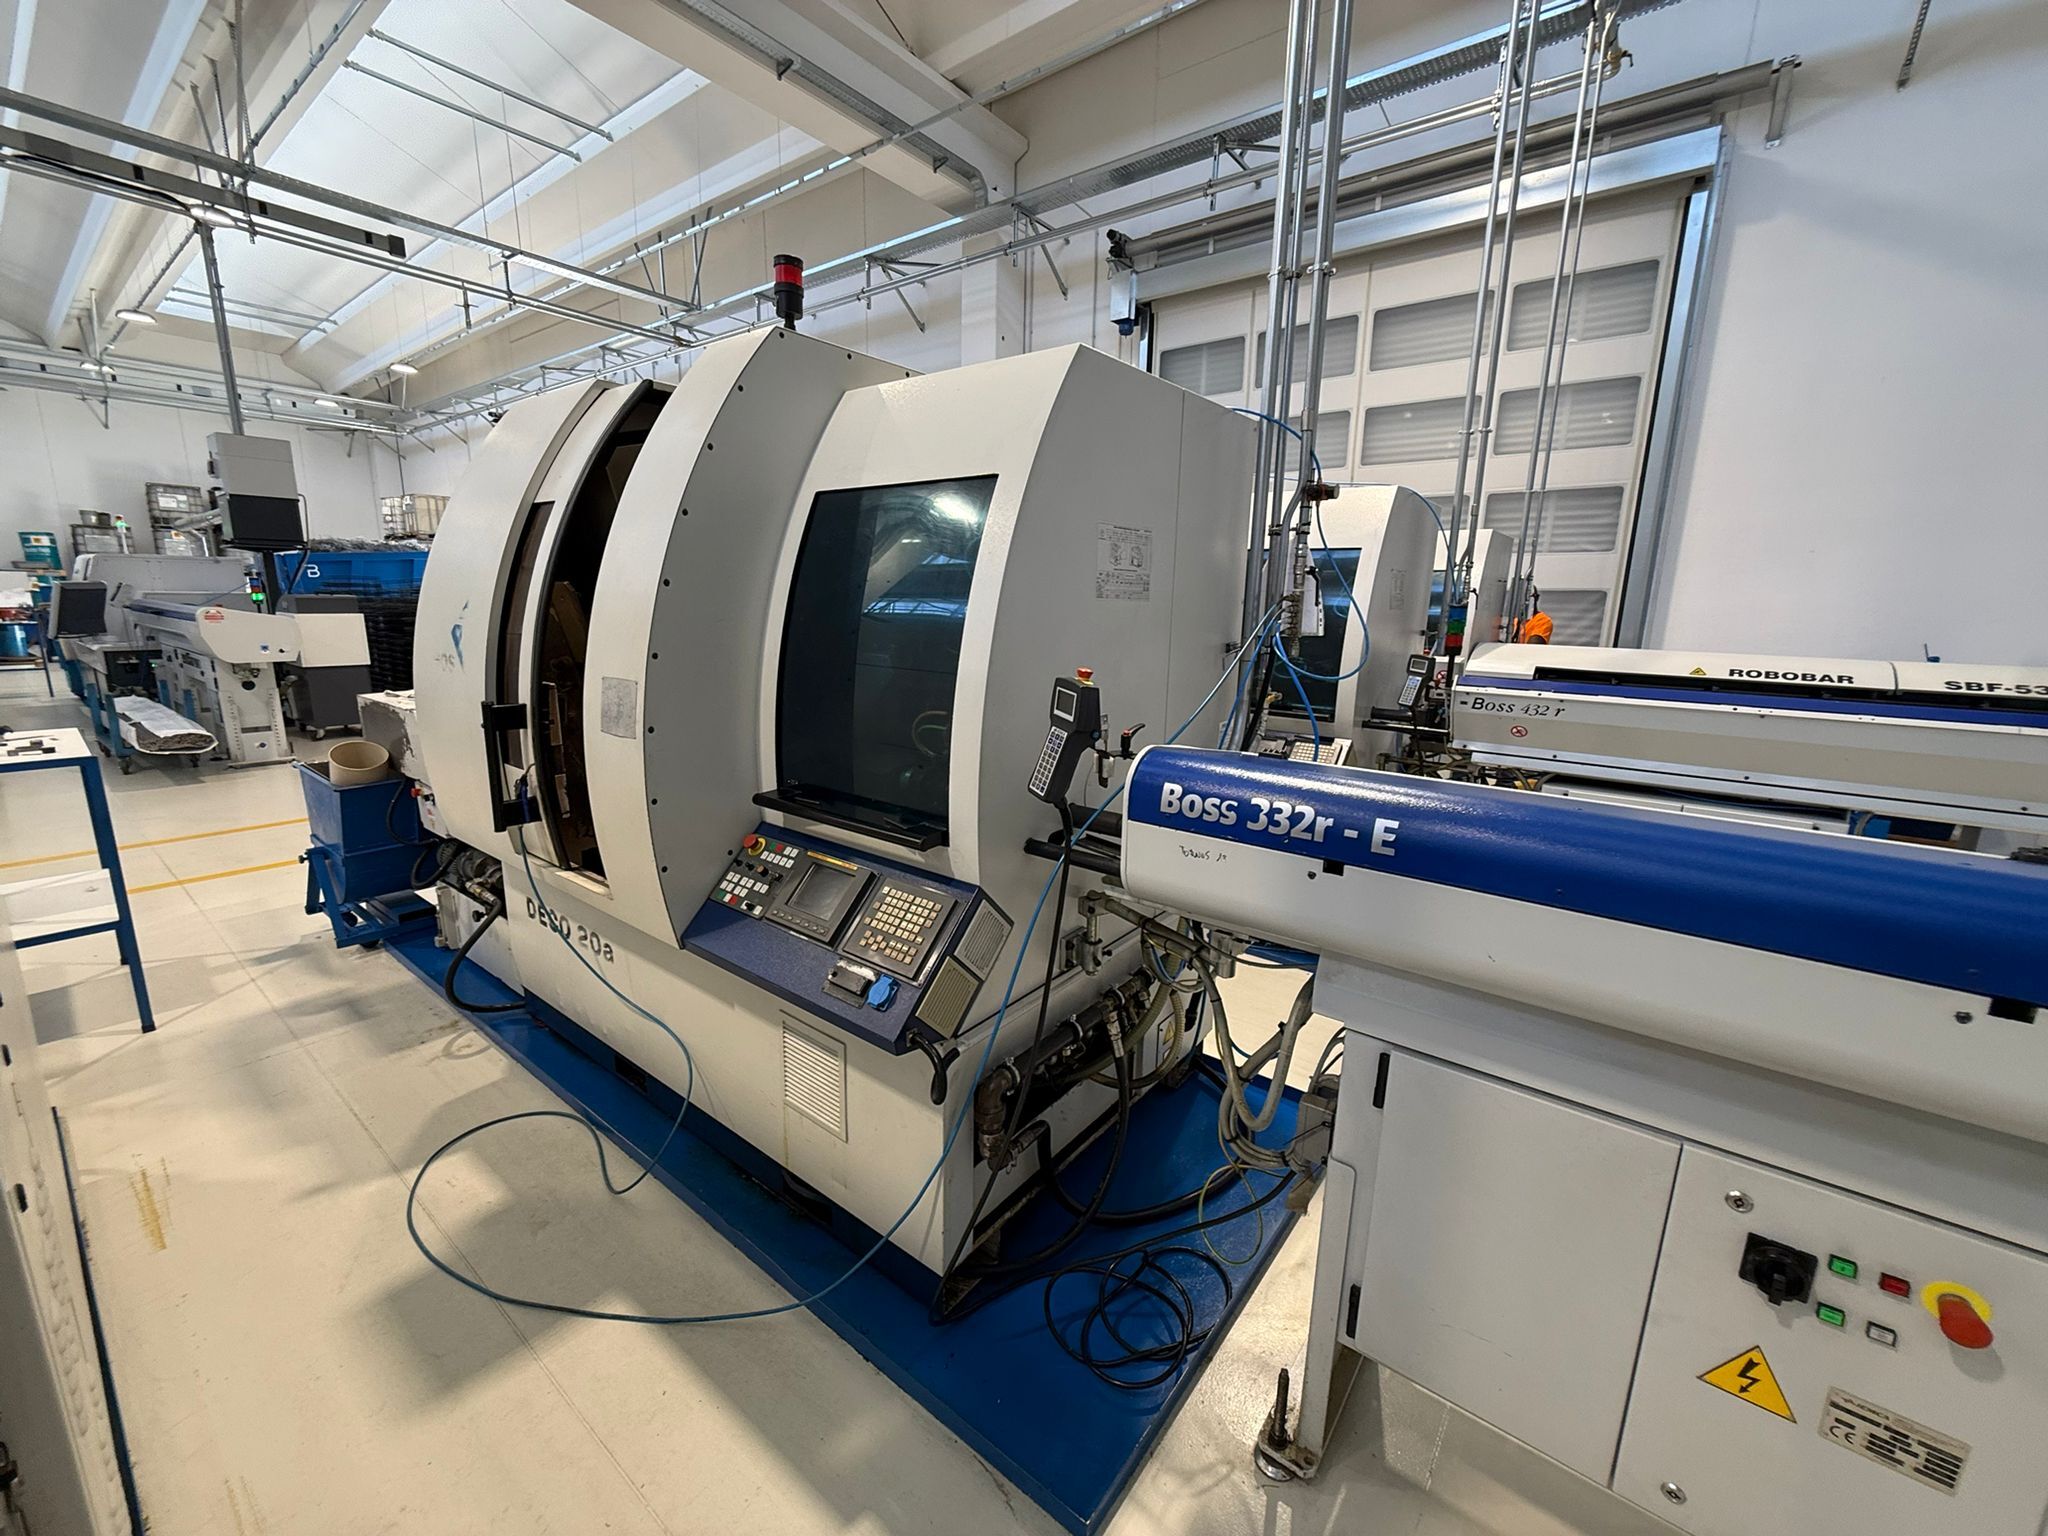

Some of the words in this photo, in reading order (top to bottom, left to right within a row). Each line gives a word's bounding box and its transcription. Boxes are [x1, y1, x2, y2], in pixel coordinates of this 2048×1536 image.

[1728, 668, 1855, 684] ROBOBAR
[1944, 680, 2048, 695] SBF-53
[1471, 697, 1516, 714] Boss
[1520, 703, 1550, 717] 432
[1554, 707, 1566, 717] r
[1160, 782, 1238, 826] Boss
[1246, 797, 1335, 843] 332r
[1370, 817, 1400, 857] E
[526, 896, 571, 940] DECO
[577, 925, 614, 964] 20a
